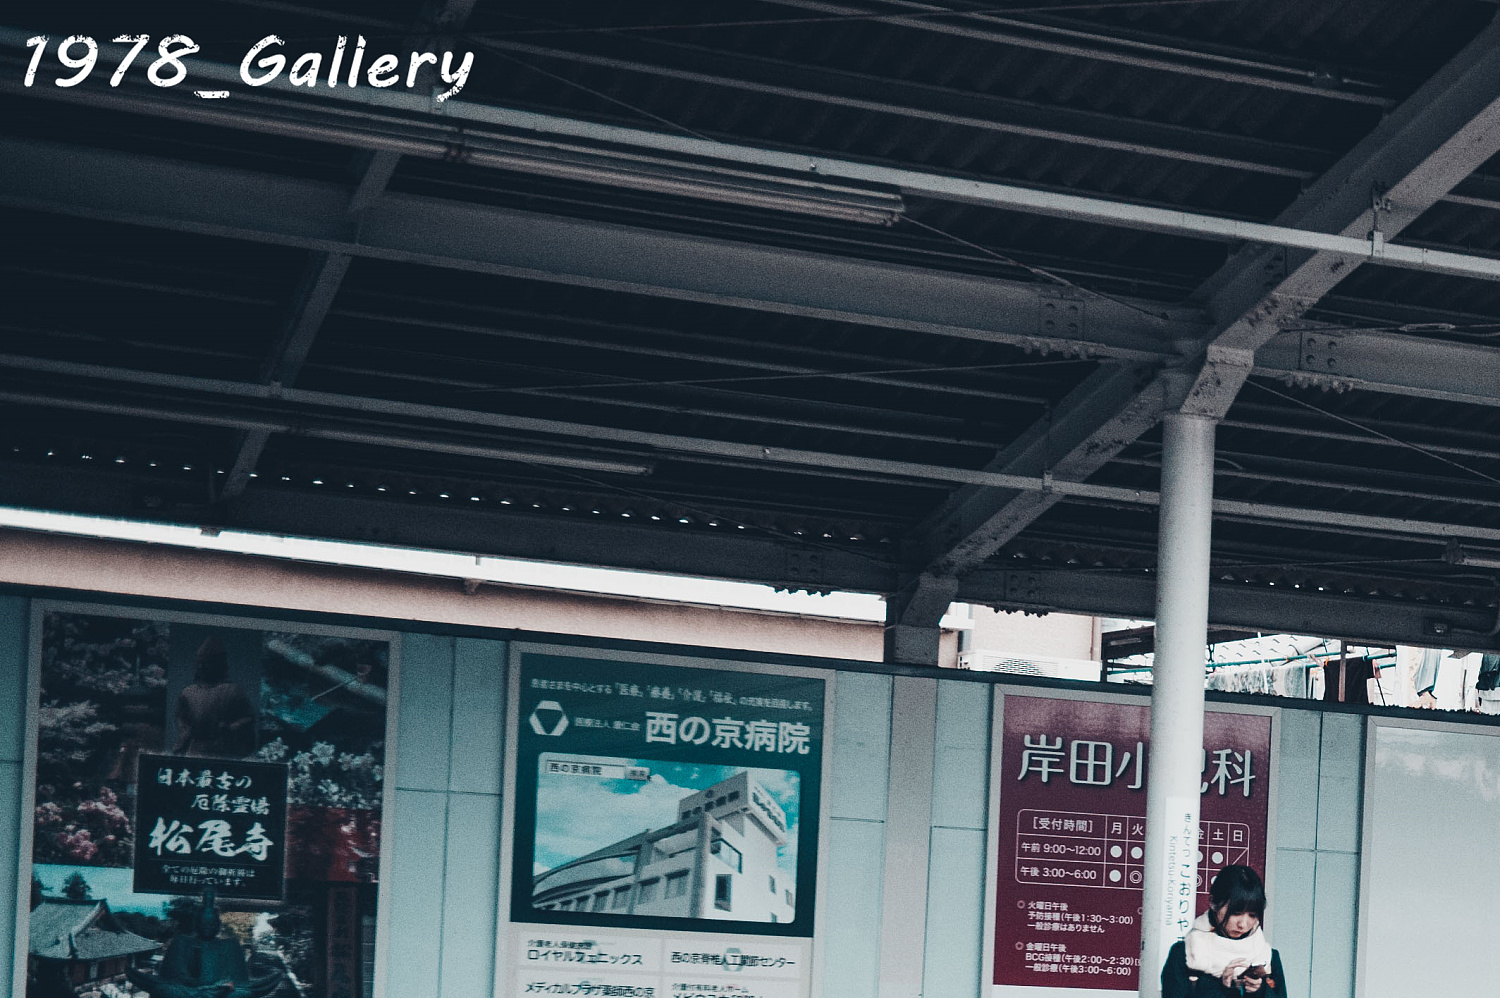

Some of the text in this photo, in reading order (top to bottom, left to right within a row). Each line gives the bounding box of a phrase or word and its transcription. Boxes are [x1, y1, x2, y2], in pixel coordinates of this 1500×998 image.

[645, 711, 811, 755] 西の京病院
[1017, 734, 1256, 798] 岸田小科
[1111, 823, 1123, 834] 月
[1131, 823, 1144, 835] 火
[1212, 828, 1225, 841] 土
[148, 816, 274, 861] 松尾寺
[1233, 830, 1244, 842] 日
[1021, 842, 1041, 853] 午前
[1020, 866, 1040, 878] 午後
[527, 949, 643, 965] ロイヤルフェニックス
